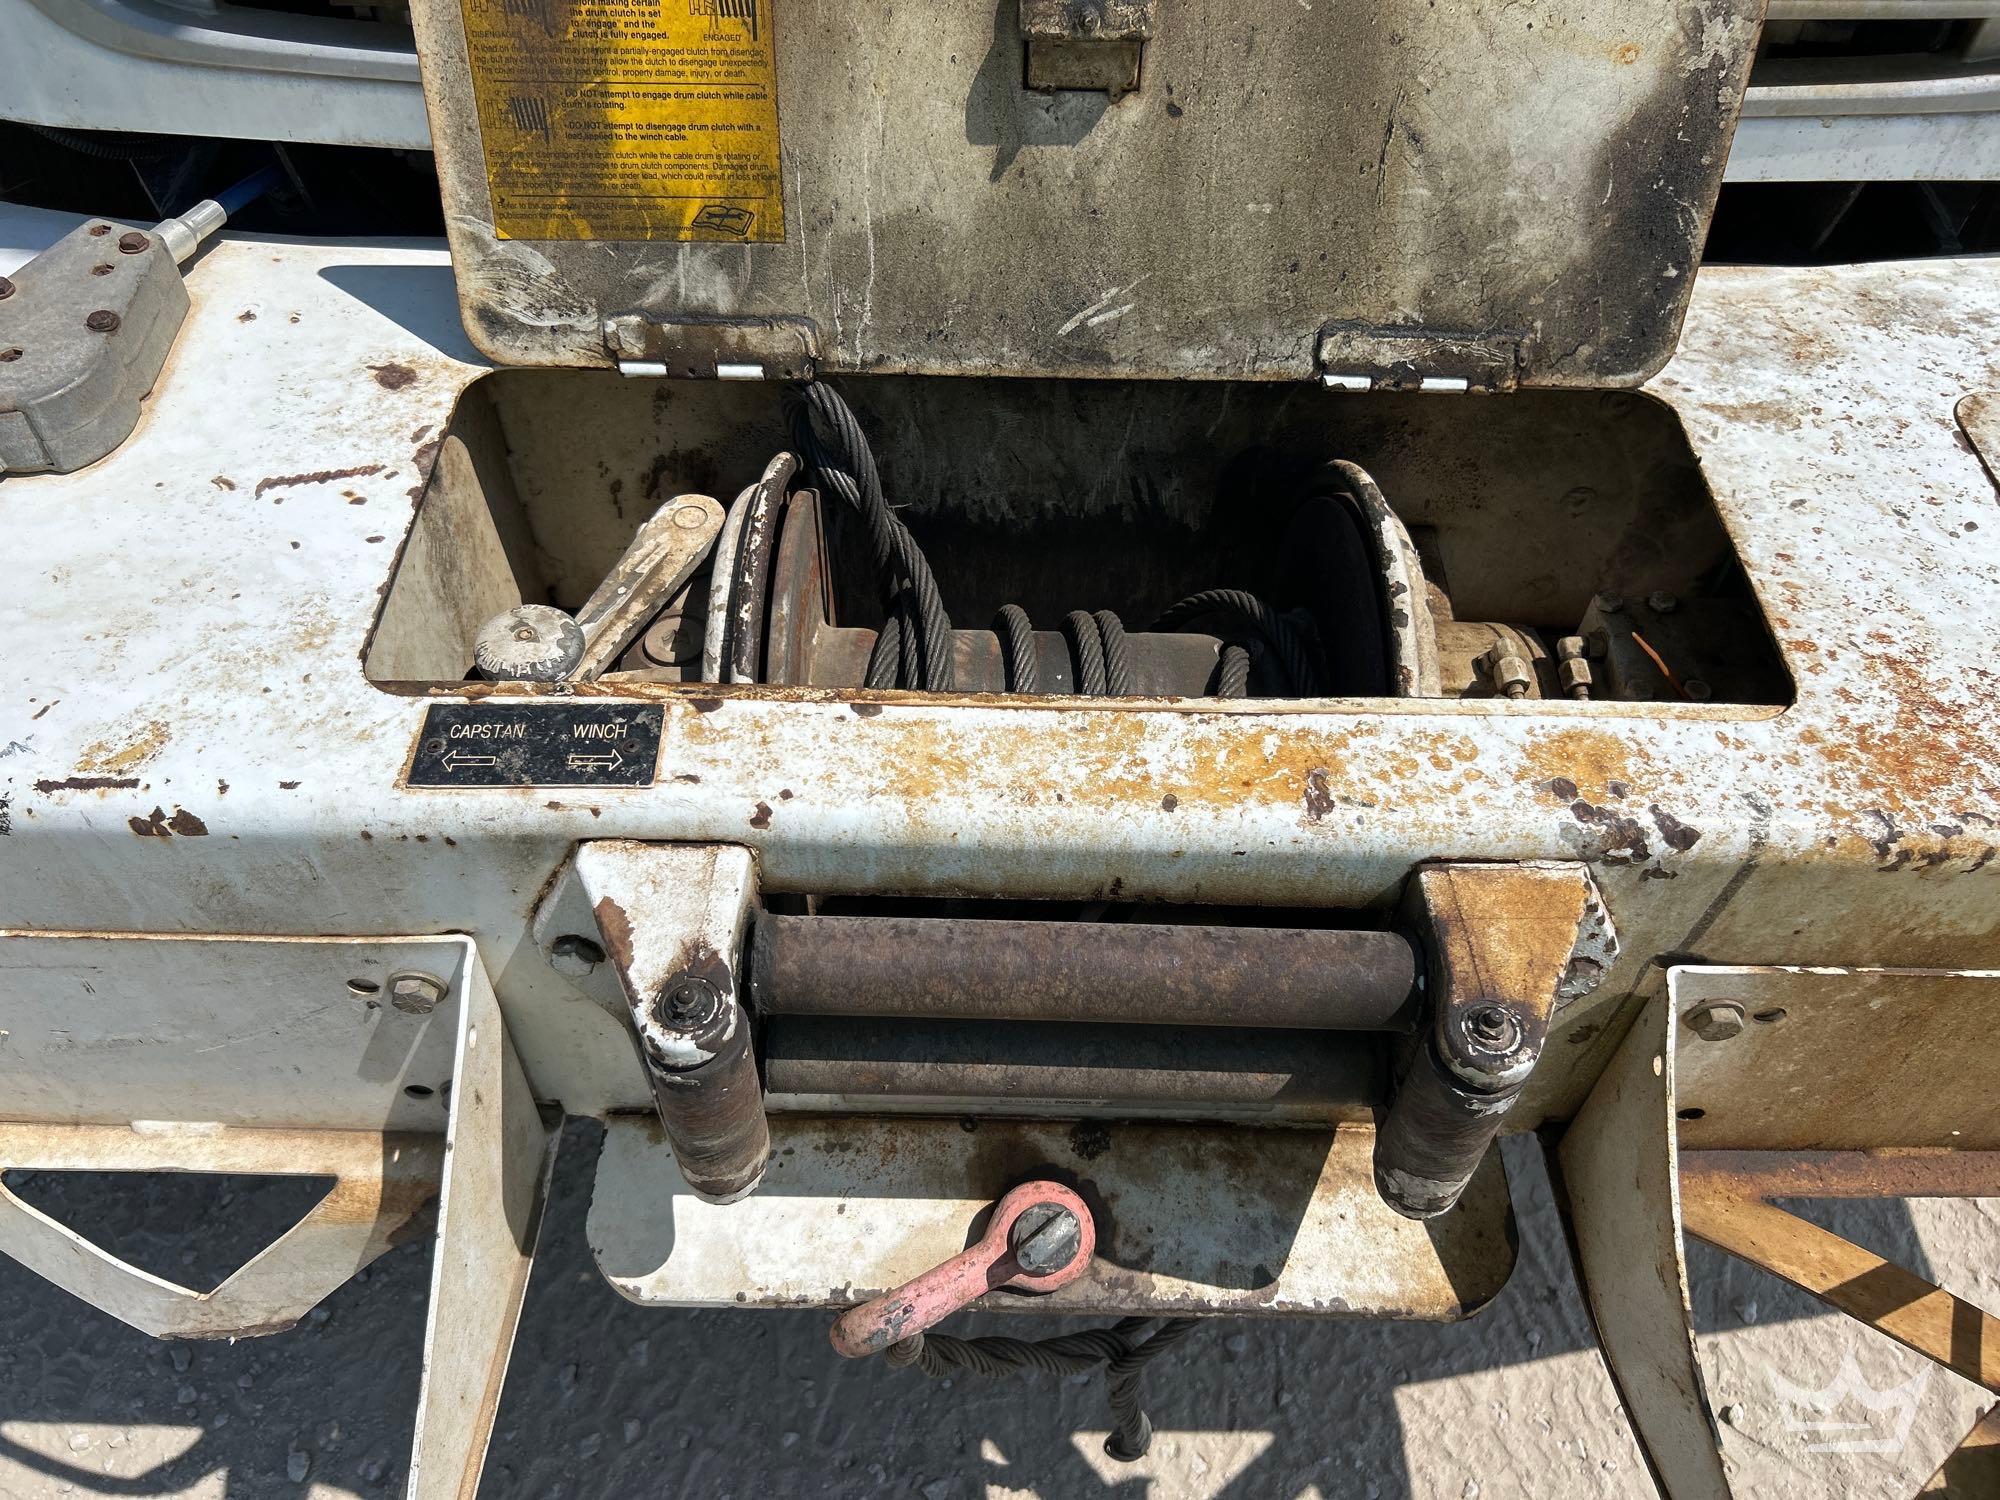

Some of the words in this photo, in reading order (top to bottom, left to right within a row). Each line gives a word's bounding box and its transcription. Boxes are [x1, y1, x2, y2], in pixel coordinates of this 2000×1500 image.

[570, 8, 583, 17] the
[585, 9, 608, 17] drum
[610, 9, 636, 17] clutch
[647, 10, 661, 18] set
[624, 20, 640, 28] and
[642, 20, 656, 28] the
[572, 29, 598, 38] clutch
[609, 31, 629, 40] fully
[630, 31, 669, 40] engaged.
[703, 34, 741, 42] ENGAGED
[620, 47, 685, 57] partially-engaged
[687, 48, 709, 56] clutch
[592, 58, 607, 66] may
[609, 58, 629, 66] allow
[631, 58, 644, 66] the
[645, 58, 668, 66] clutch
[669, 58, 677, 66] to
[678, 58, 718, 68] disengage
[622, 69, 653, 78] property
[655, 69, 687, 79] damage,
[580, 90, 598, 98] NOT
[600, 90, 630, 100] attempt
[642, 92, 671, 101] engage
[673, 91, 695, 99] drum
[696, 91, 720, 99] clutch
[746, 92, 768, 100] cable
[593, 101, 626, 110] rotating.
[603, 122, 633, 132] attempt
[645, 122, 686, 132] disengage
[688, 123, 709, 131] drum
[711, 123, 735, 131] clutch
[615, 132, 623, 140] to
[625, 132, 637, 140] the
[640, 133, 663, 141] winch
[665, 133, 688, 141] cable.
[616, 151, 638, 159] clutch
[673, 152, 693, 160] cable
[620, 161, 640, 169] drum
[641, 161, 662, 170] clutch
[618, 172, 640, 180] under
[641, 172, 660, 181] load,
[662, 172, 682, 180] which
[684, 172, 704, 181] could
[705, 173, 725, 181] result
[450, 724, 526, 739] CAPSTAN
[573, 724, 628, 739] WINCH
